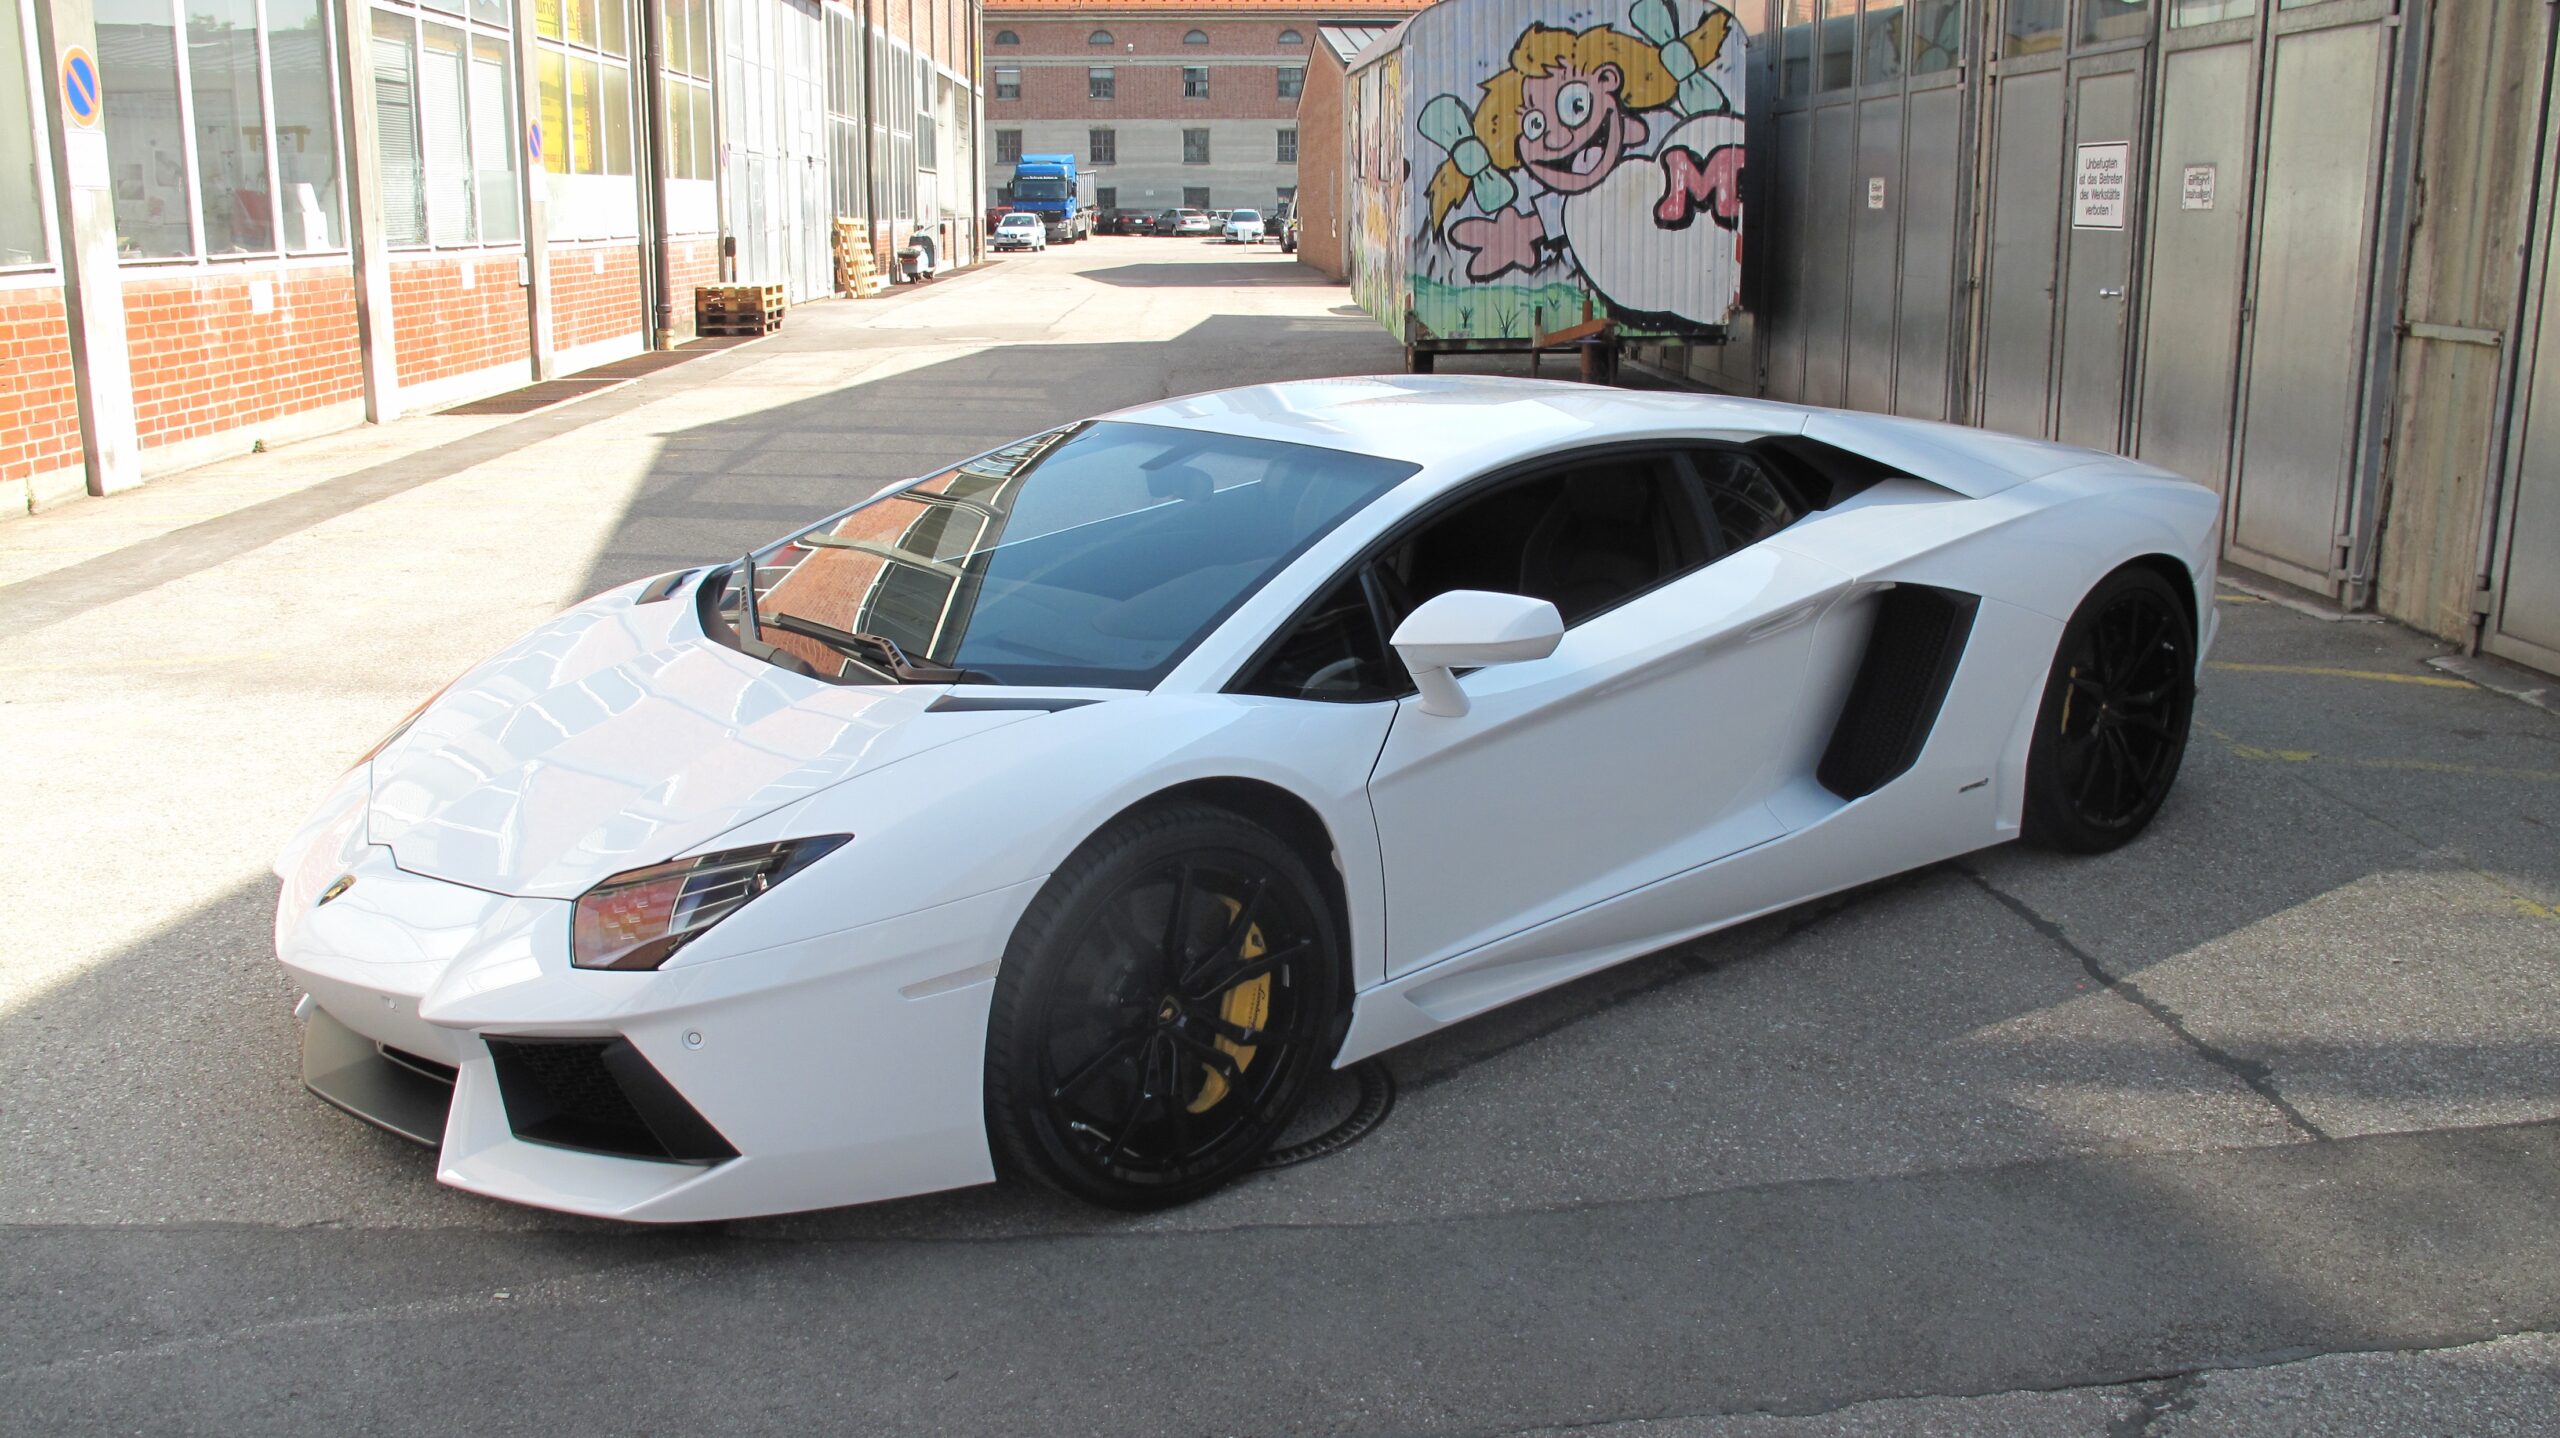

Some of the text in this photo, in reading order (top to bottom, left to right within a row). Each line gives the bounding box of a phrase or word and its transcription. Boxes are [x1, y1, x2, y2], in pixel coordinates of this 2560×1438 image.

[2086, 158, 2117, 171] Unbefugten
[2088, 173, 2097, 185] das
[2099, 172, 2123, 185] Betreten
[2080, 188, 2120, 200] der Werkstätte
[2085, 204, 2109, 216] verboten
